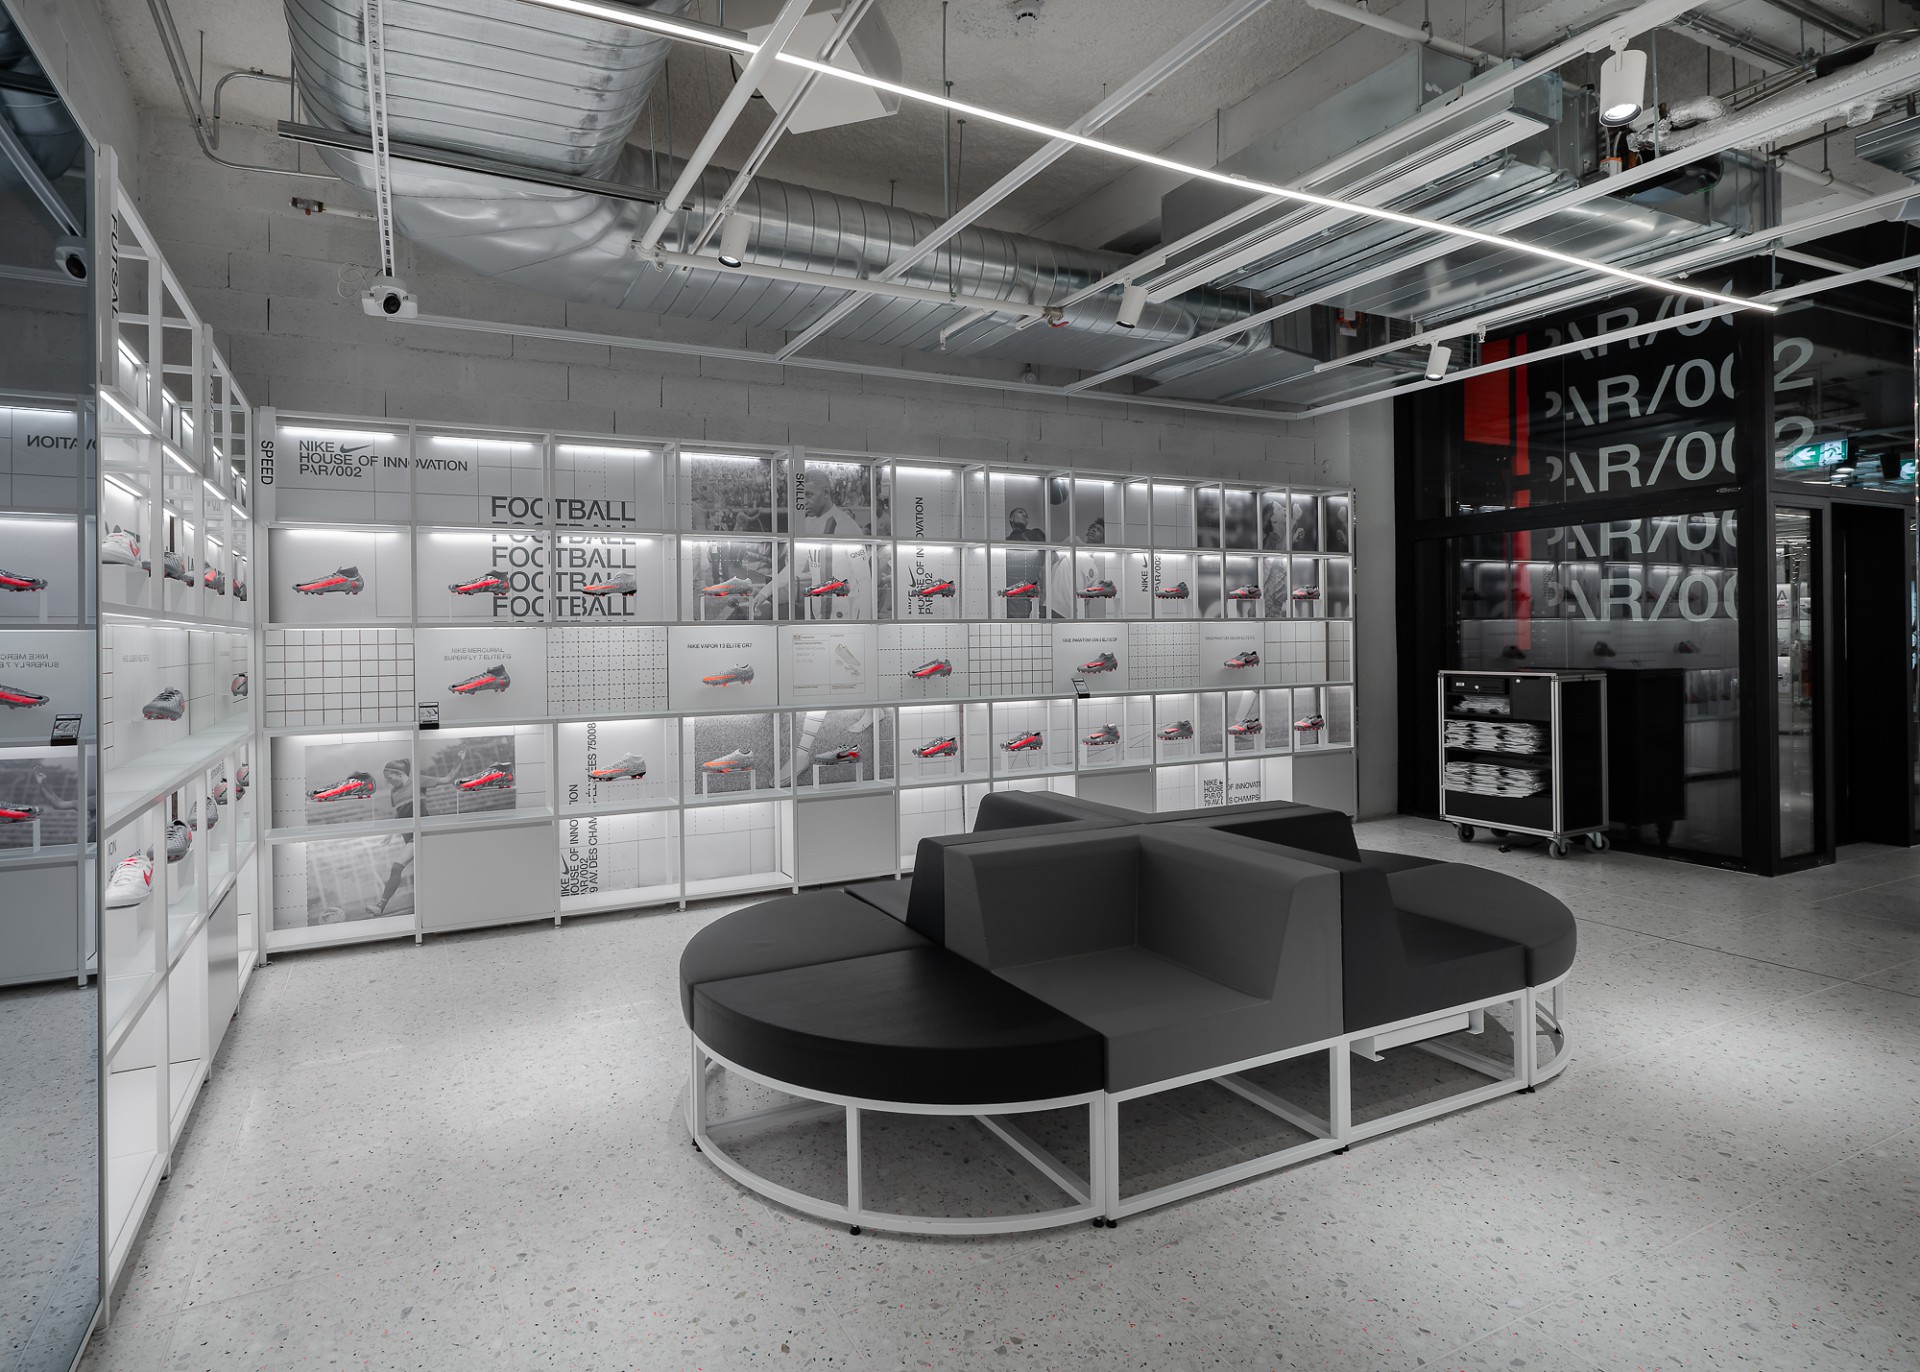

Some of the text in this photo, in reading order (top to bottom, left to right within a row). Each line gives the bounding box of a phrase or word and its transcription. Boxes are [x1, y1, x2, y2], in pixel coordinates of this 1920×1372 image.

[299, 440, 334, 453] NIKE
[261, 440, 274, 485] SPEED
[299, 452, 353, 466] HOUSE
[358, 455, 378, 467] OF
[299, 464, 362, 477] PAR/002
[796, 473, 804, 511] SKILLS
[491, 496, 636, 522] FOOTBALL
[492, 546, 637, 569] FOOTBALL
[916, 561, 924, 575] OF
[1141, 571, 1149, 592] NIKE
[587, 723, 597, 751] 75008
[570, 847, 579, 862] OF
[589, 848, 598, 869] DES
[560, 878, 570, 897] IKE
